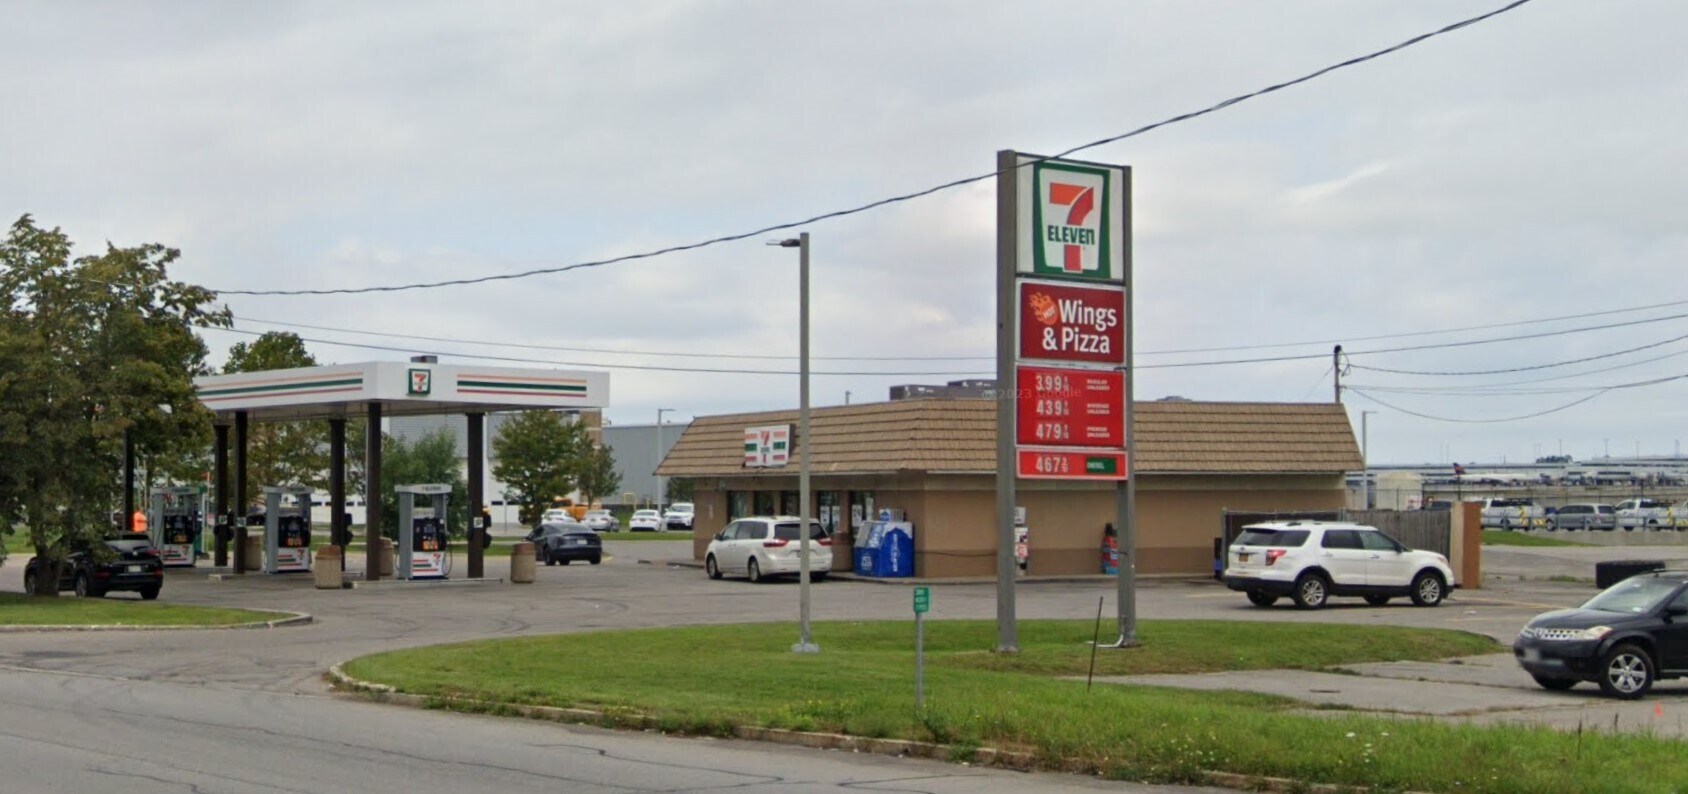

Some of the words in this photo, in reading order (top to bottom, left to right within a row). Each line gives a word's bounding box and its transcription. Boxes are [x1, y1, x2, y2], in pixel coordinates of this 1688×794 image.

[1058, 299, 1117, 332] Wings
[1042, 327, 1057, 350] &
[1062, 327, 1110, 354] Pizza
